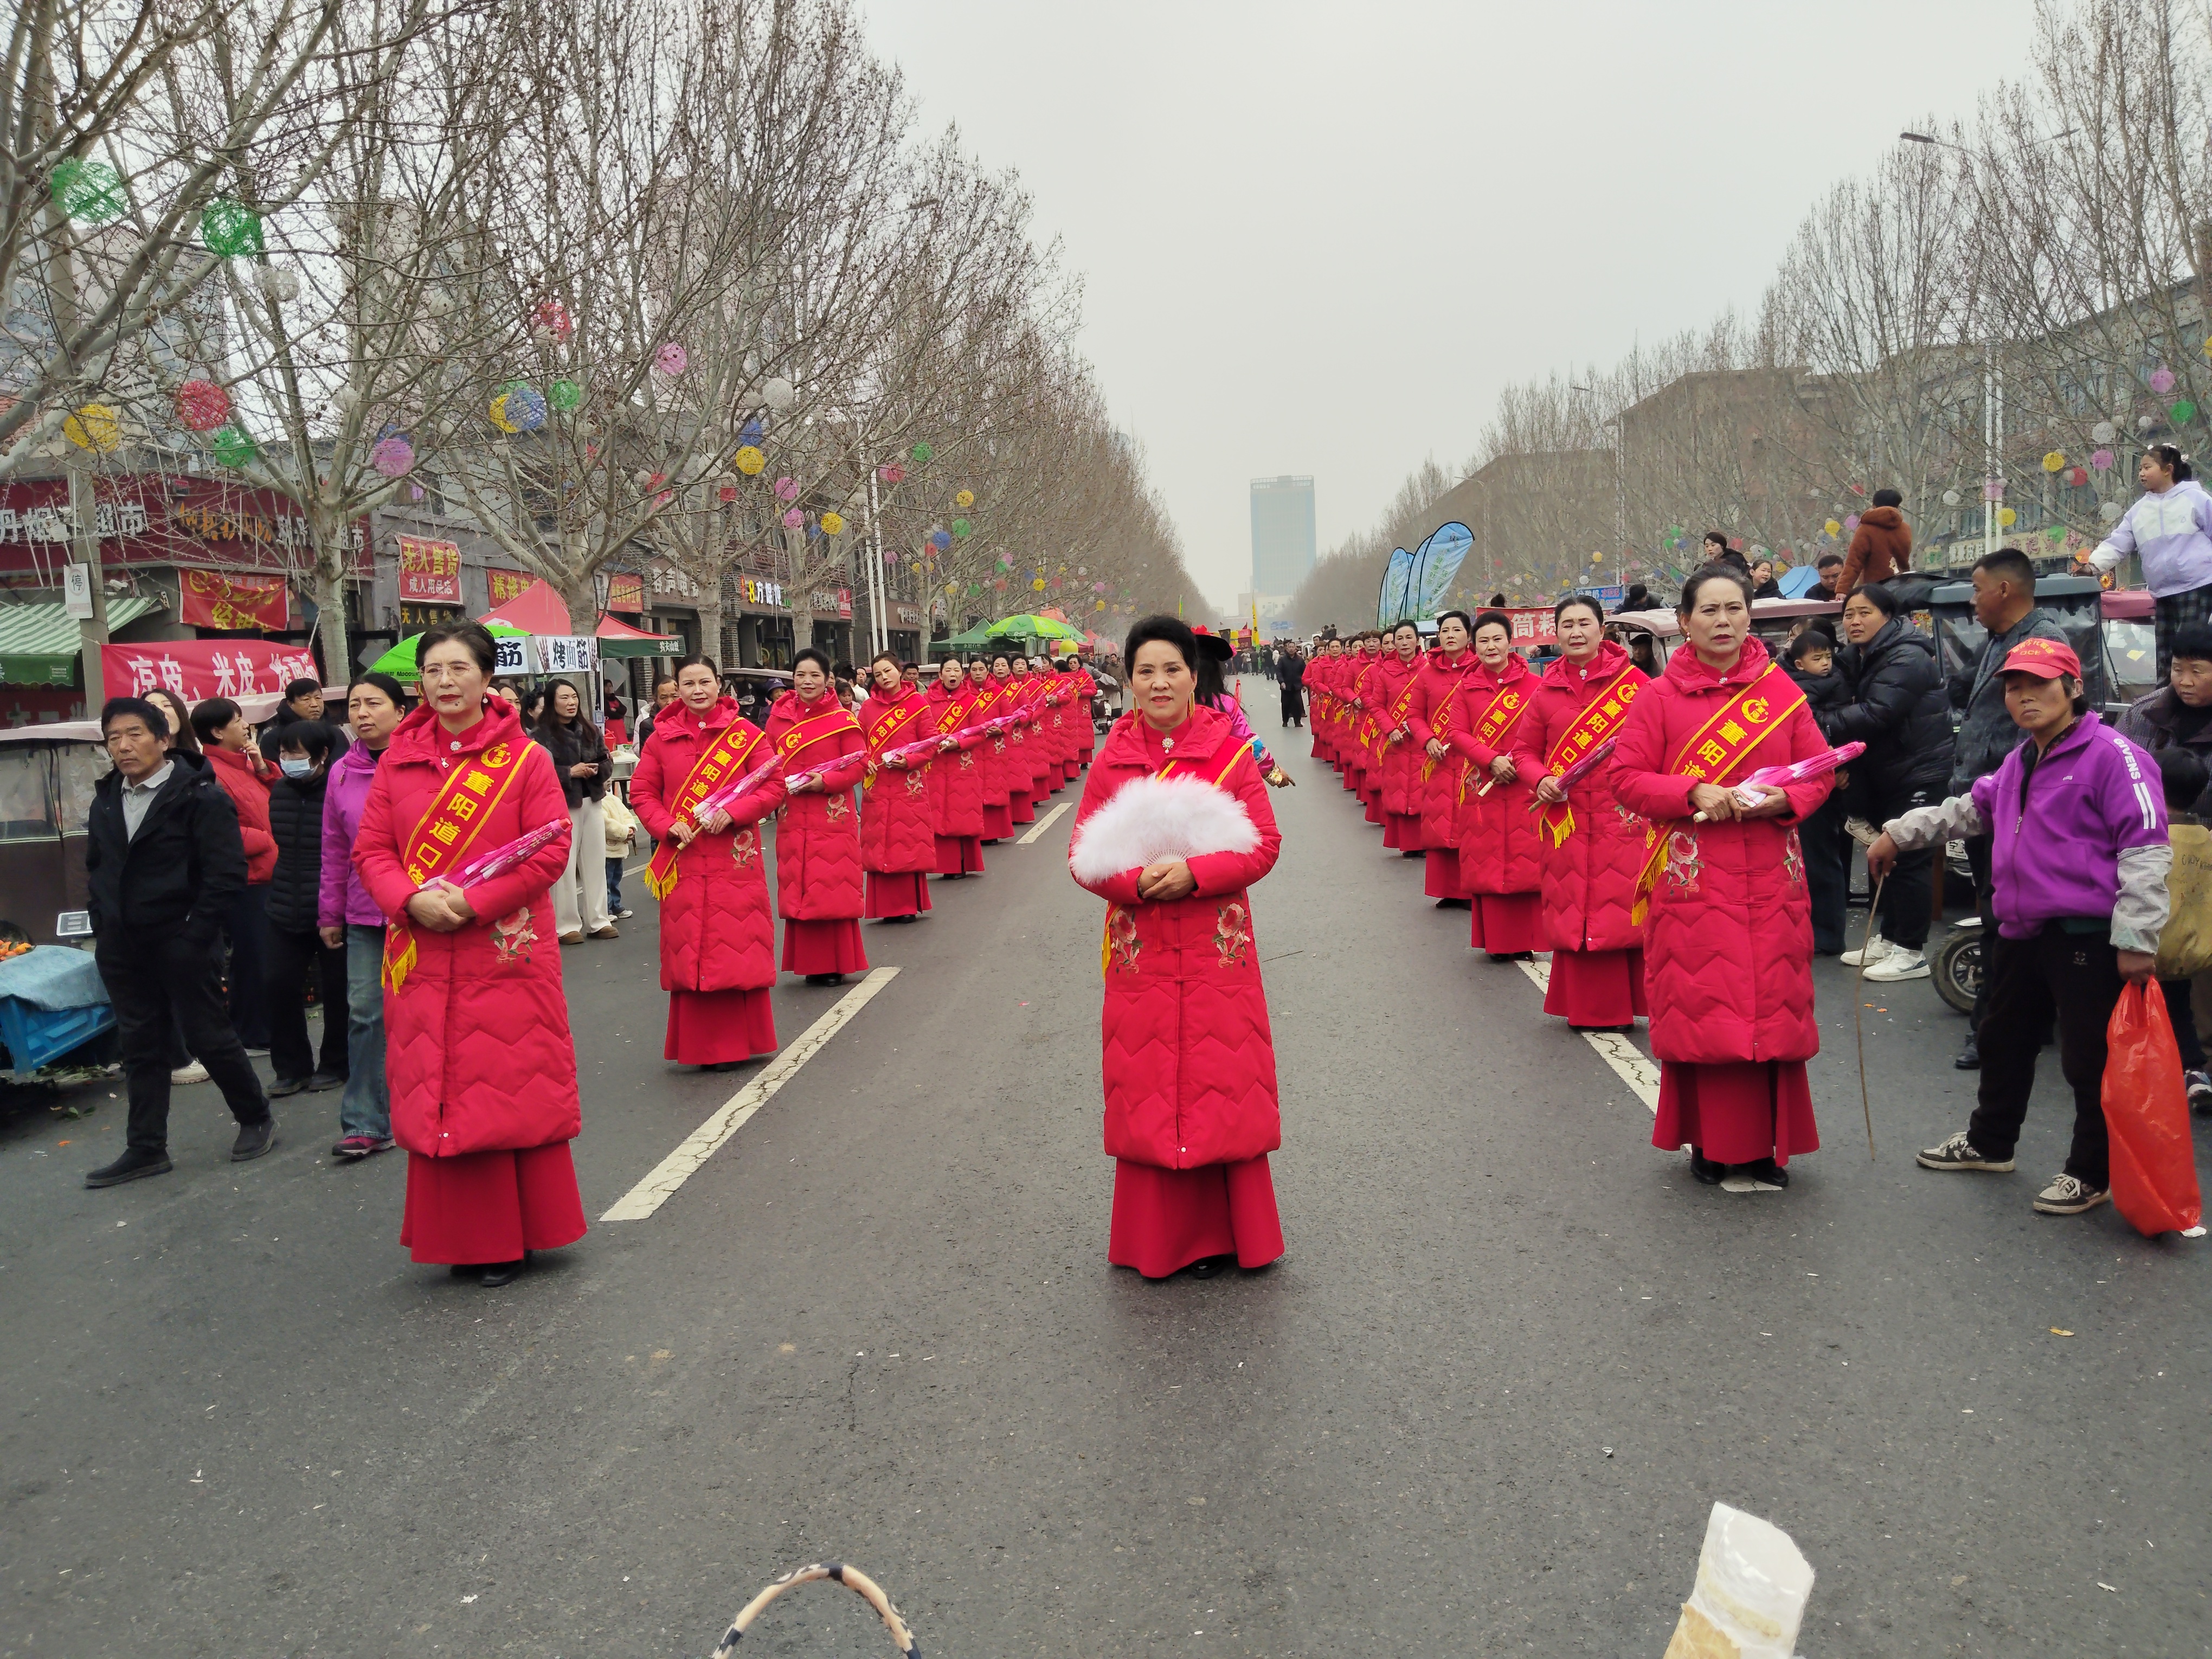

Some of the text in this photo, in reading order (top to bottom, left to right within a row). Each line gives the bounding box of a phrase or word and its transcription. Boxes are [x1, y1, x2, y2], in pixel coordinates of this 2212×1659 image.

[403, 543, 459, 577] 无人售货
[71, 574, 83, 591] 停
[409, 576, 453, 595] 成人用品店
[493, 574, 538, 600] 精修电
[552, 638, 589, 670] 烤面筋
[2113, 738, 2141, 780] GIVENS
